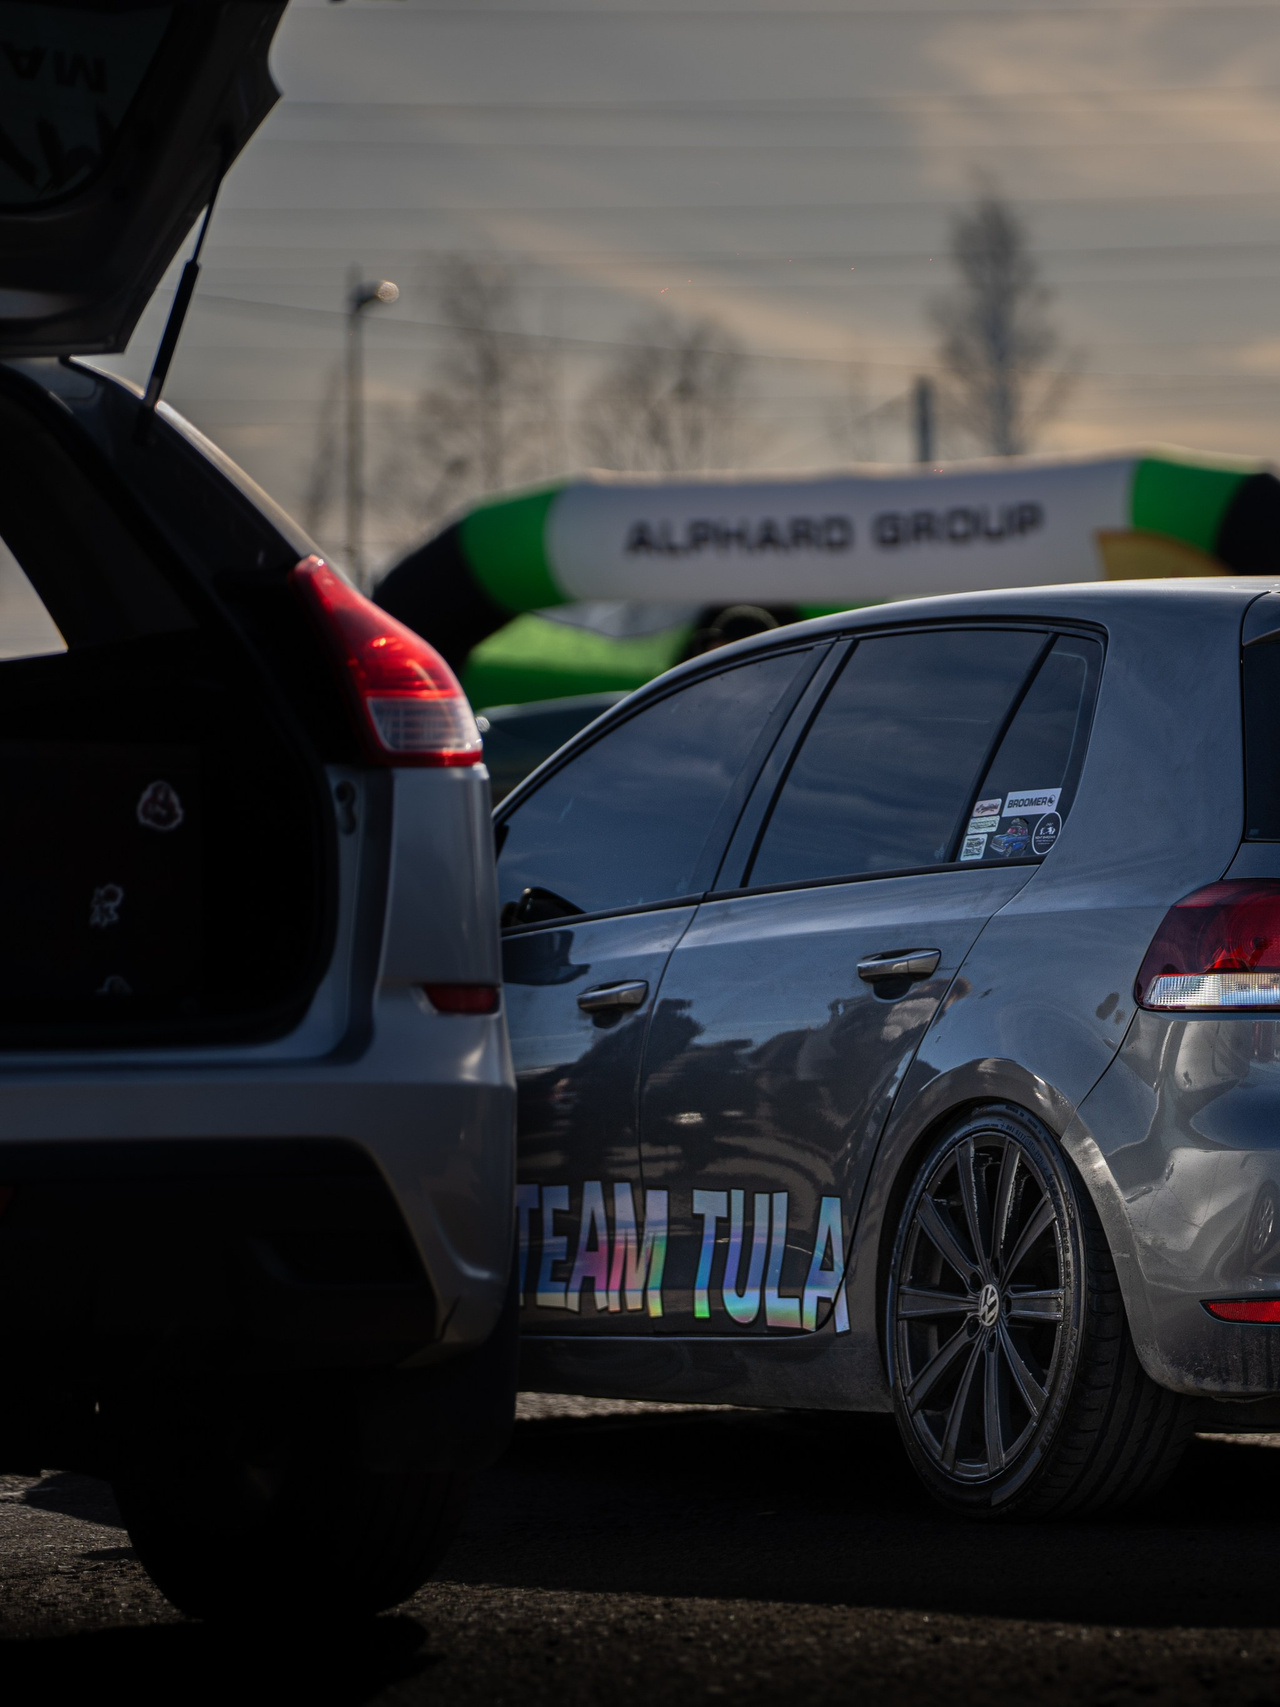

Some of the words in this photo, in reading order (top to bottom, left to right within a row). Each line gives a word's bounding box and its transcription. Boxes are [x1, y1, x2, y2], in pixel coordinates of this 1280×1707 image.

[626, 518, 853, 554] ALPHARD
[873, 502, 1044, 547] GROUP
[1007, 797, 1048, 809] BROOMER
[516, 1180, 669, 1319] TEAM
[692, 1188, 851, 1334] TULA
